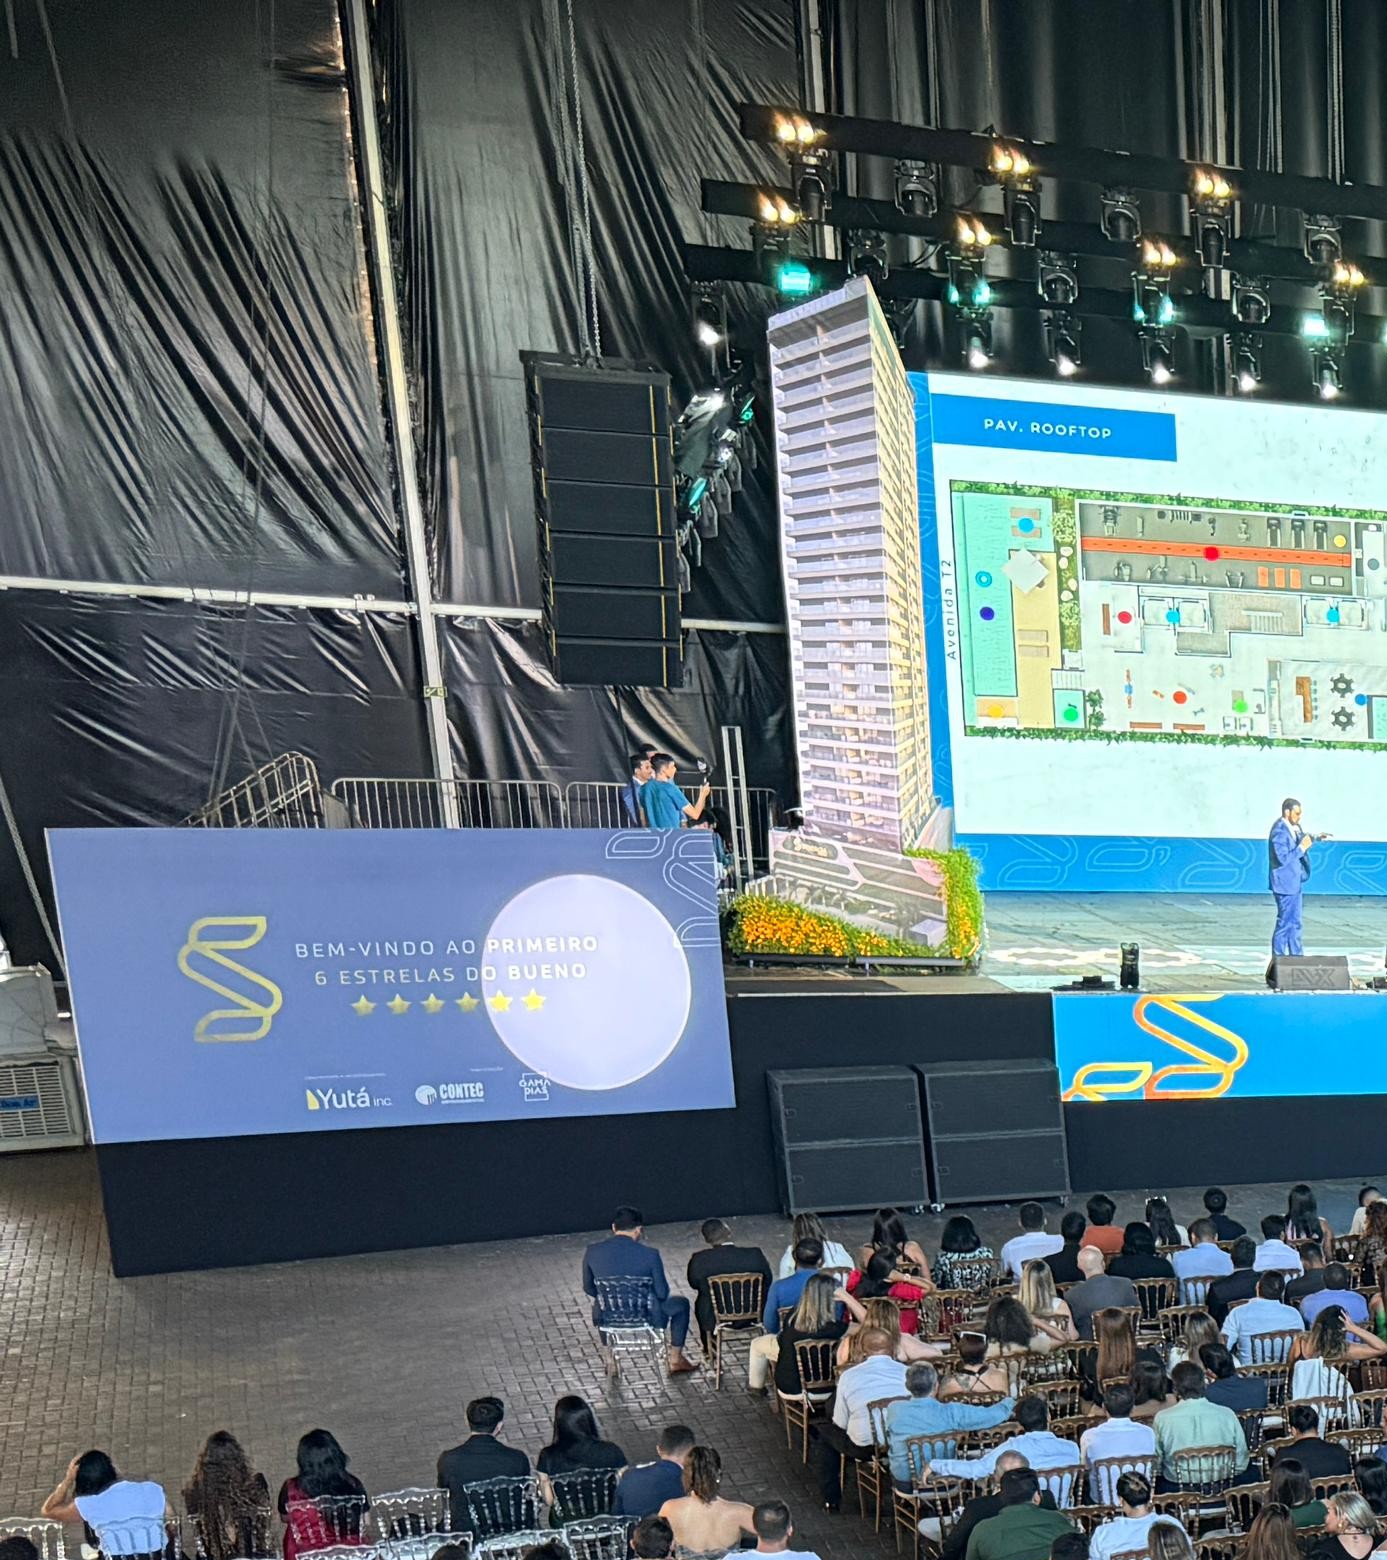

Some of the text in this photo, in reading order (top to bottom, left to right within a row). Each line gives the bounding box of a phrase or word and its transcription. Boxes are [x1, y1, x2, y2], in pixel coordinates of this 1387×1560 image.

[984, 418, 1112, 439] PAV. ROOFTOP
[941, 560, 956, 660] Avenida T2
[295, 936, 598, 958] BEM-VINDO AO PRIMEIRO
[315, 963, 587, 985] 6 ESTRELAS DO BUENO
[439, 1082, 484, 1100] CONTEC
[519, 1079, 551, 1087] GAMA
[317, 1086, 370, 1109] Yutá
